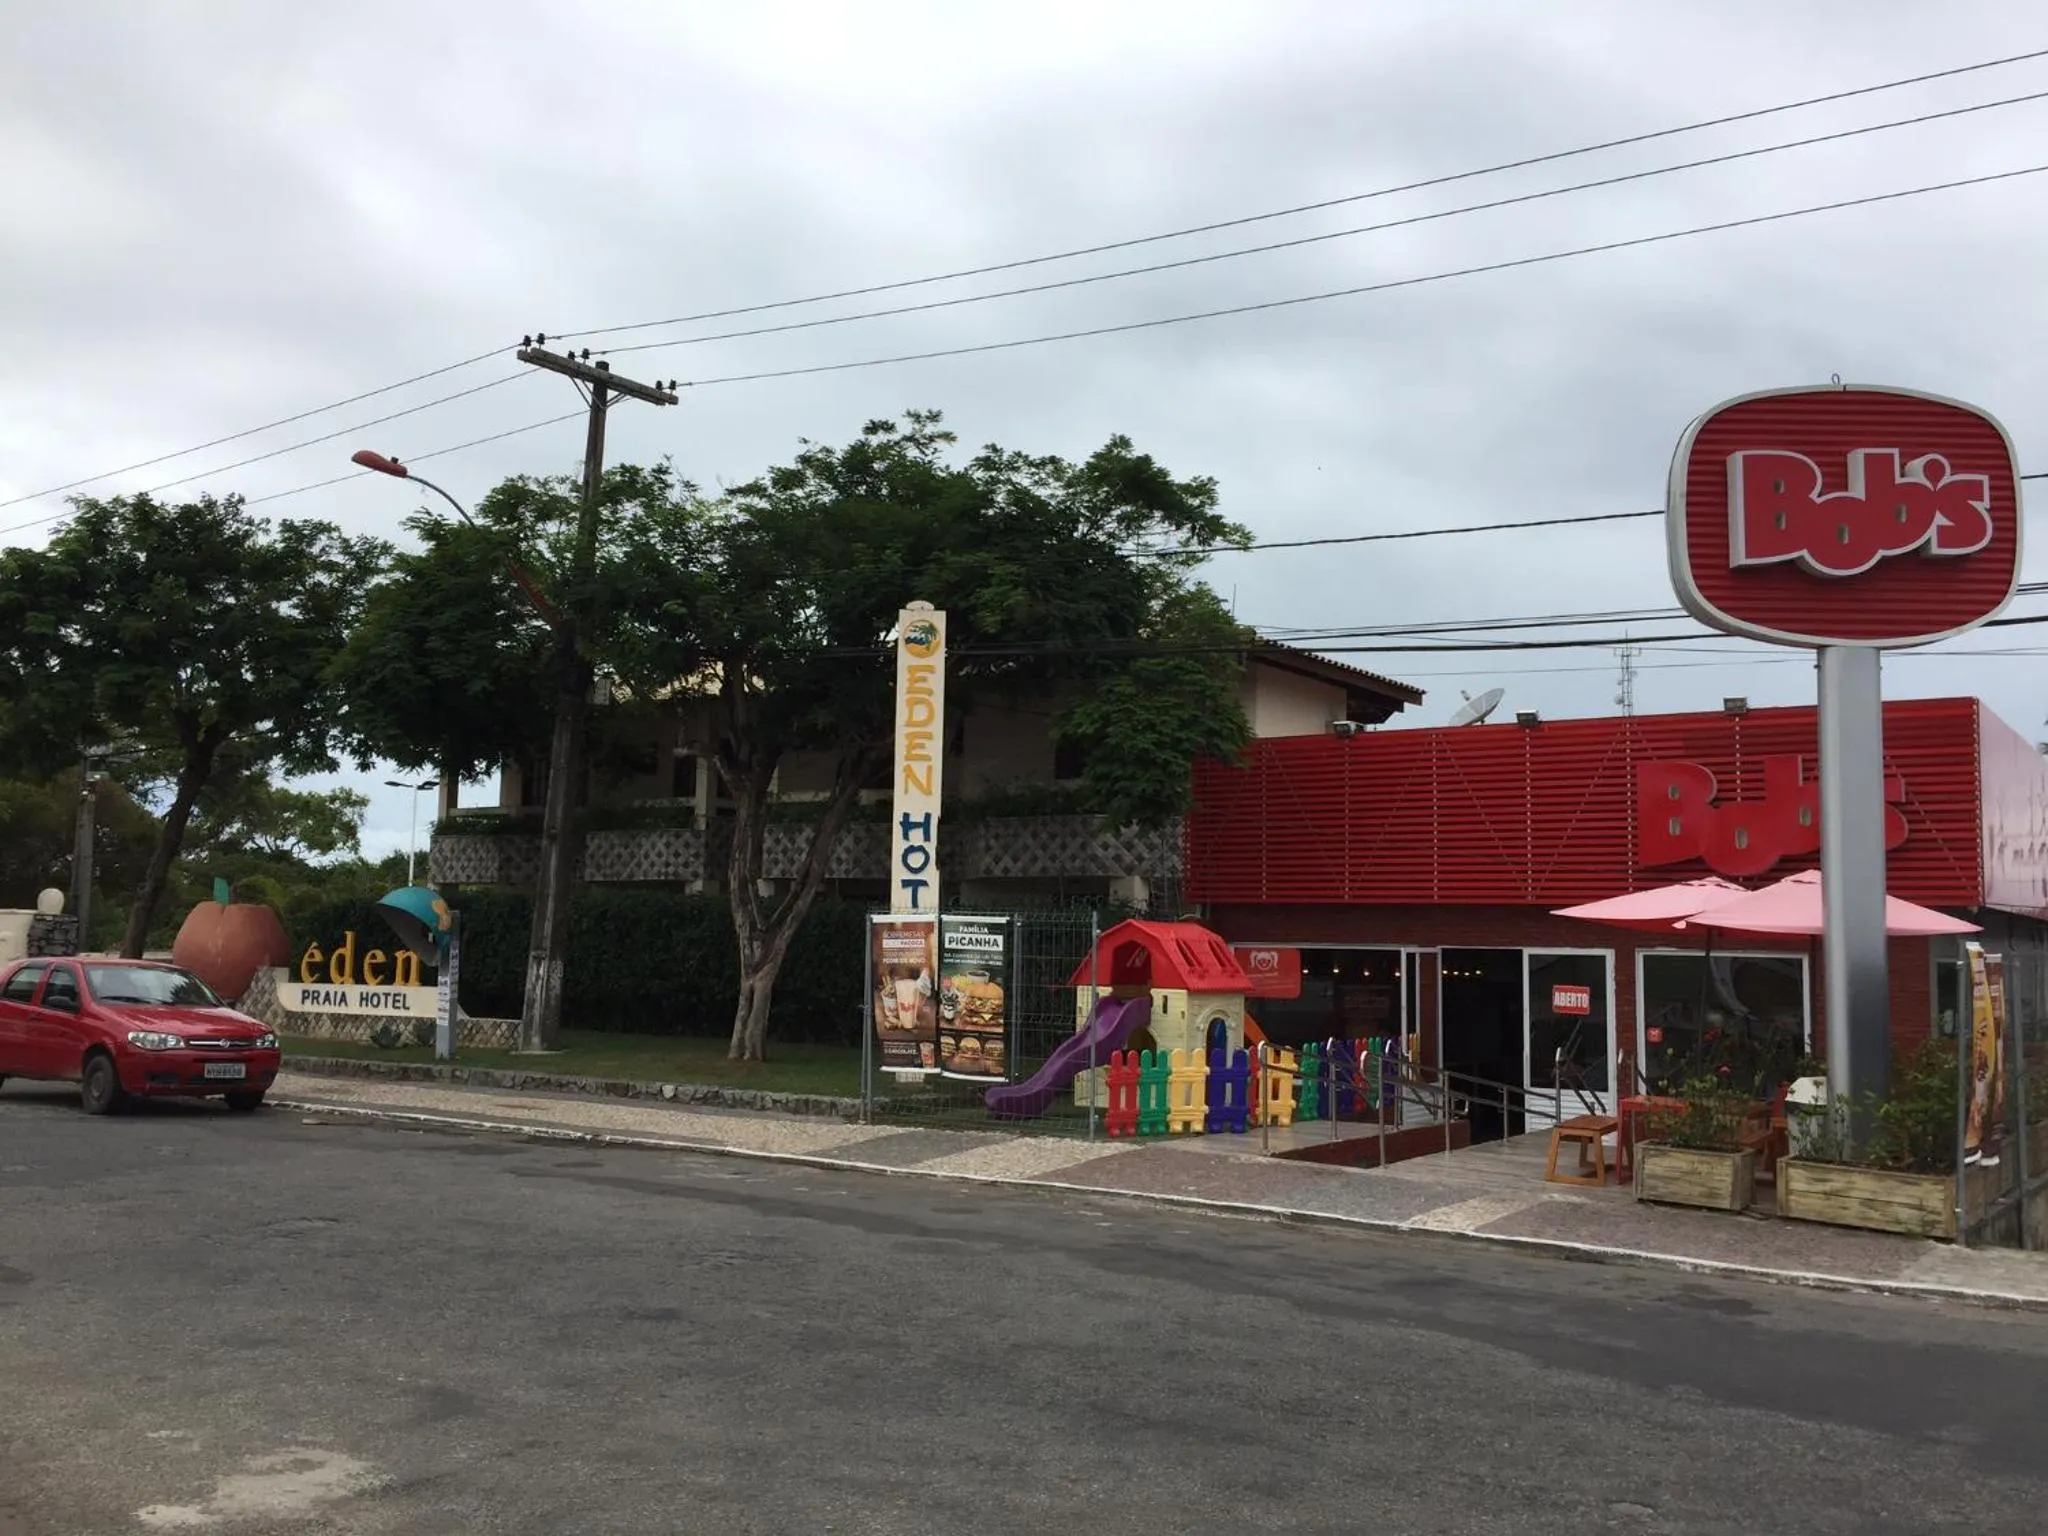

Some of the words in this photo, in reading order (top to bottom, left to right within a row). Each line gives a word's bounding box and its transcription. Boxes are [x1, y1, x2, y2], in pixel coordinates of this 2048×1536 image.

[1725, 447, 1993, 577] Bob's
[903, 664, 936, 797] EDEN
[1636, 754, 1909, 876] Bob
[301, 930, 422, 987] éden
[948, 936, 1000, 948] PICANHA
[301, 989, 349, 1008] PRAIA
[359, 991, 411, 1010] HOTEL
